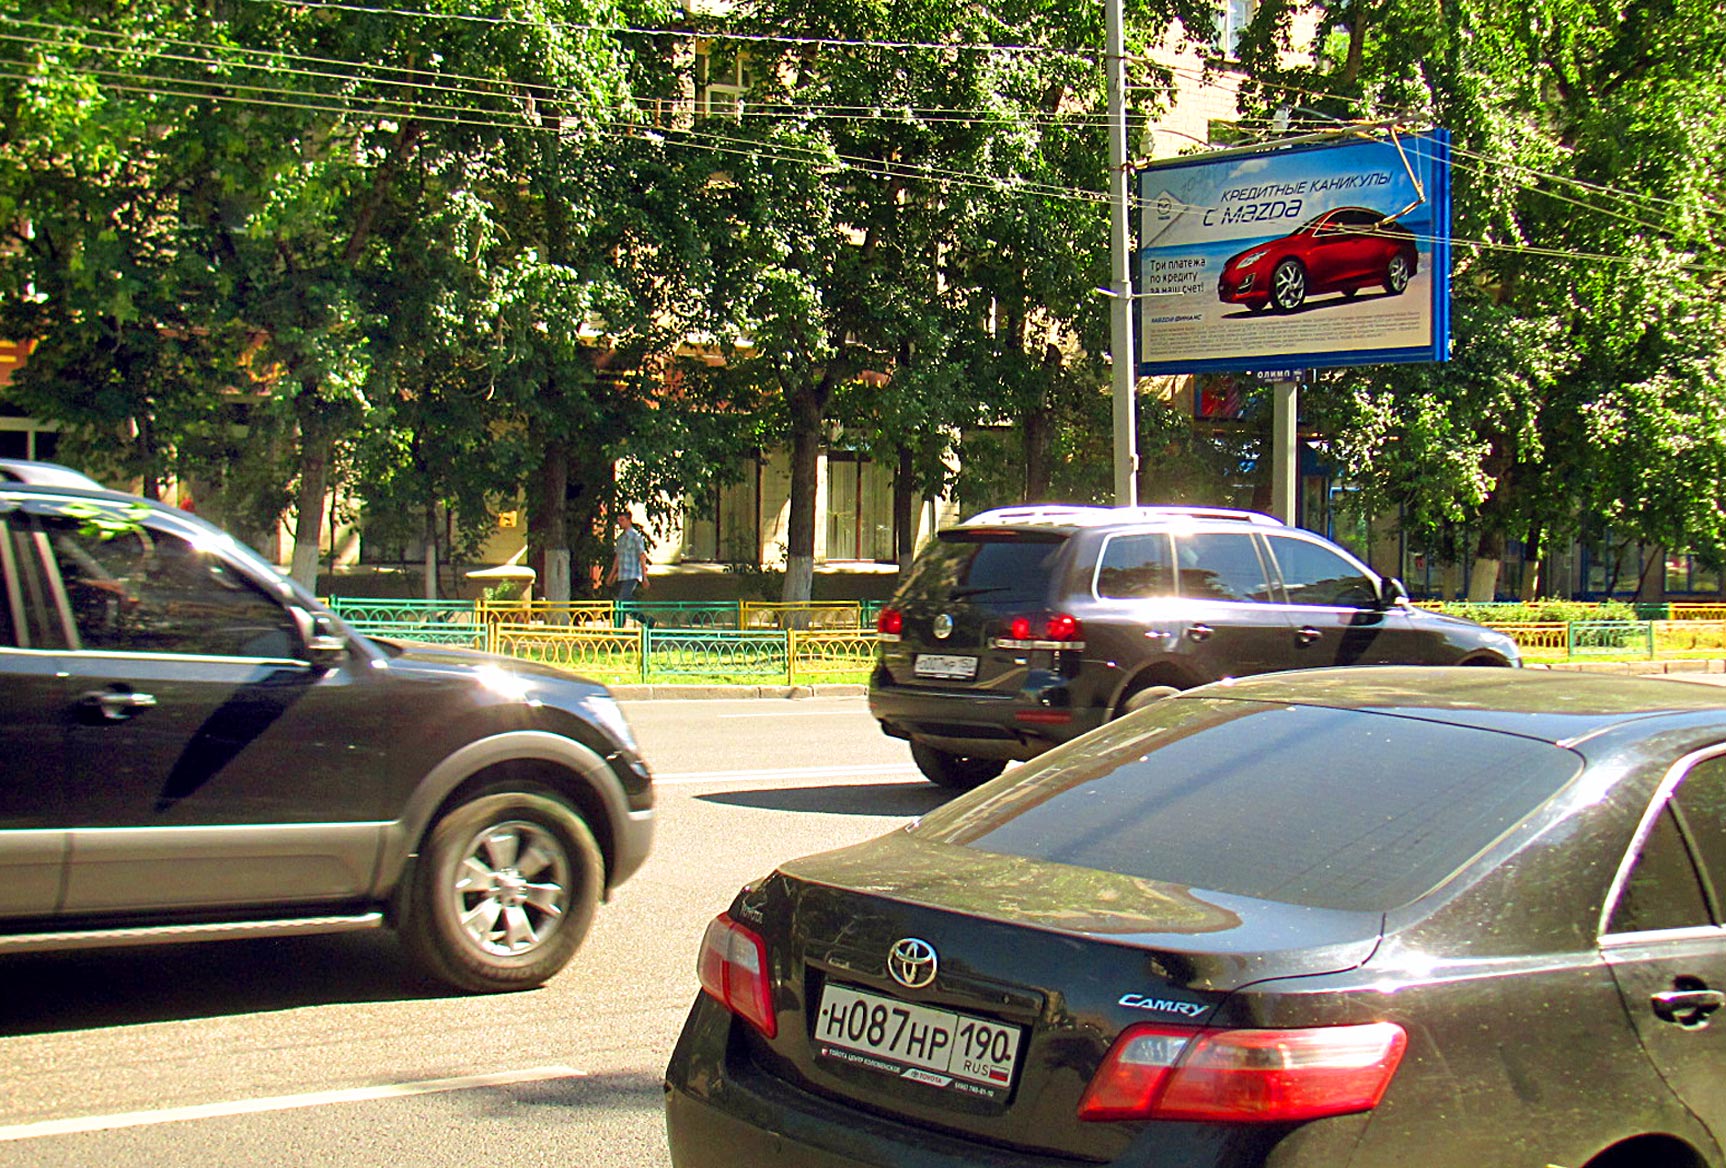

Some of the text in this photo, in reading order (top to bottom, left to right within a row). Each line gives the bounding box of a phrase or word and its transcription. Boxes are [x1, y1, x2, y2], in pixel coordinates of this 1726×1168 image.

[1221, 181, 1307, 202] КРЕДИТНЫЕ
[1310, 171, 1394, 193] КАНИКУЛЫ
[1150, 258, 1206, 271] Три платежа
[1150, 272, 1198, 283] по кредиту
[1182, 281, 1204, 294] счет!
[960, 1022, 1009, 1064] 190
[963, 1060, 989, 1076] RUS
[919, 1072, 943, 1083] TOYOTA
